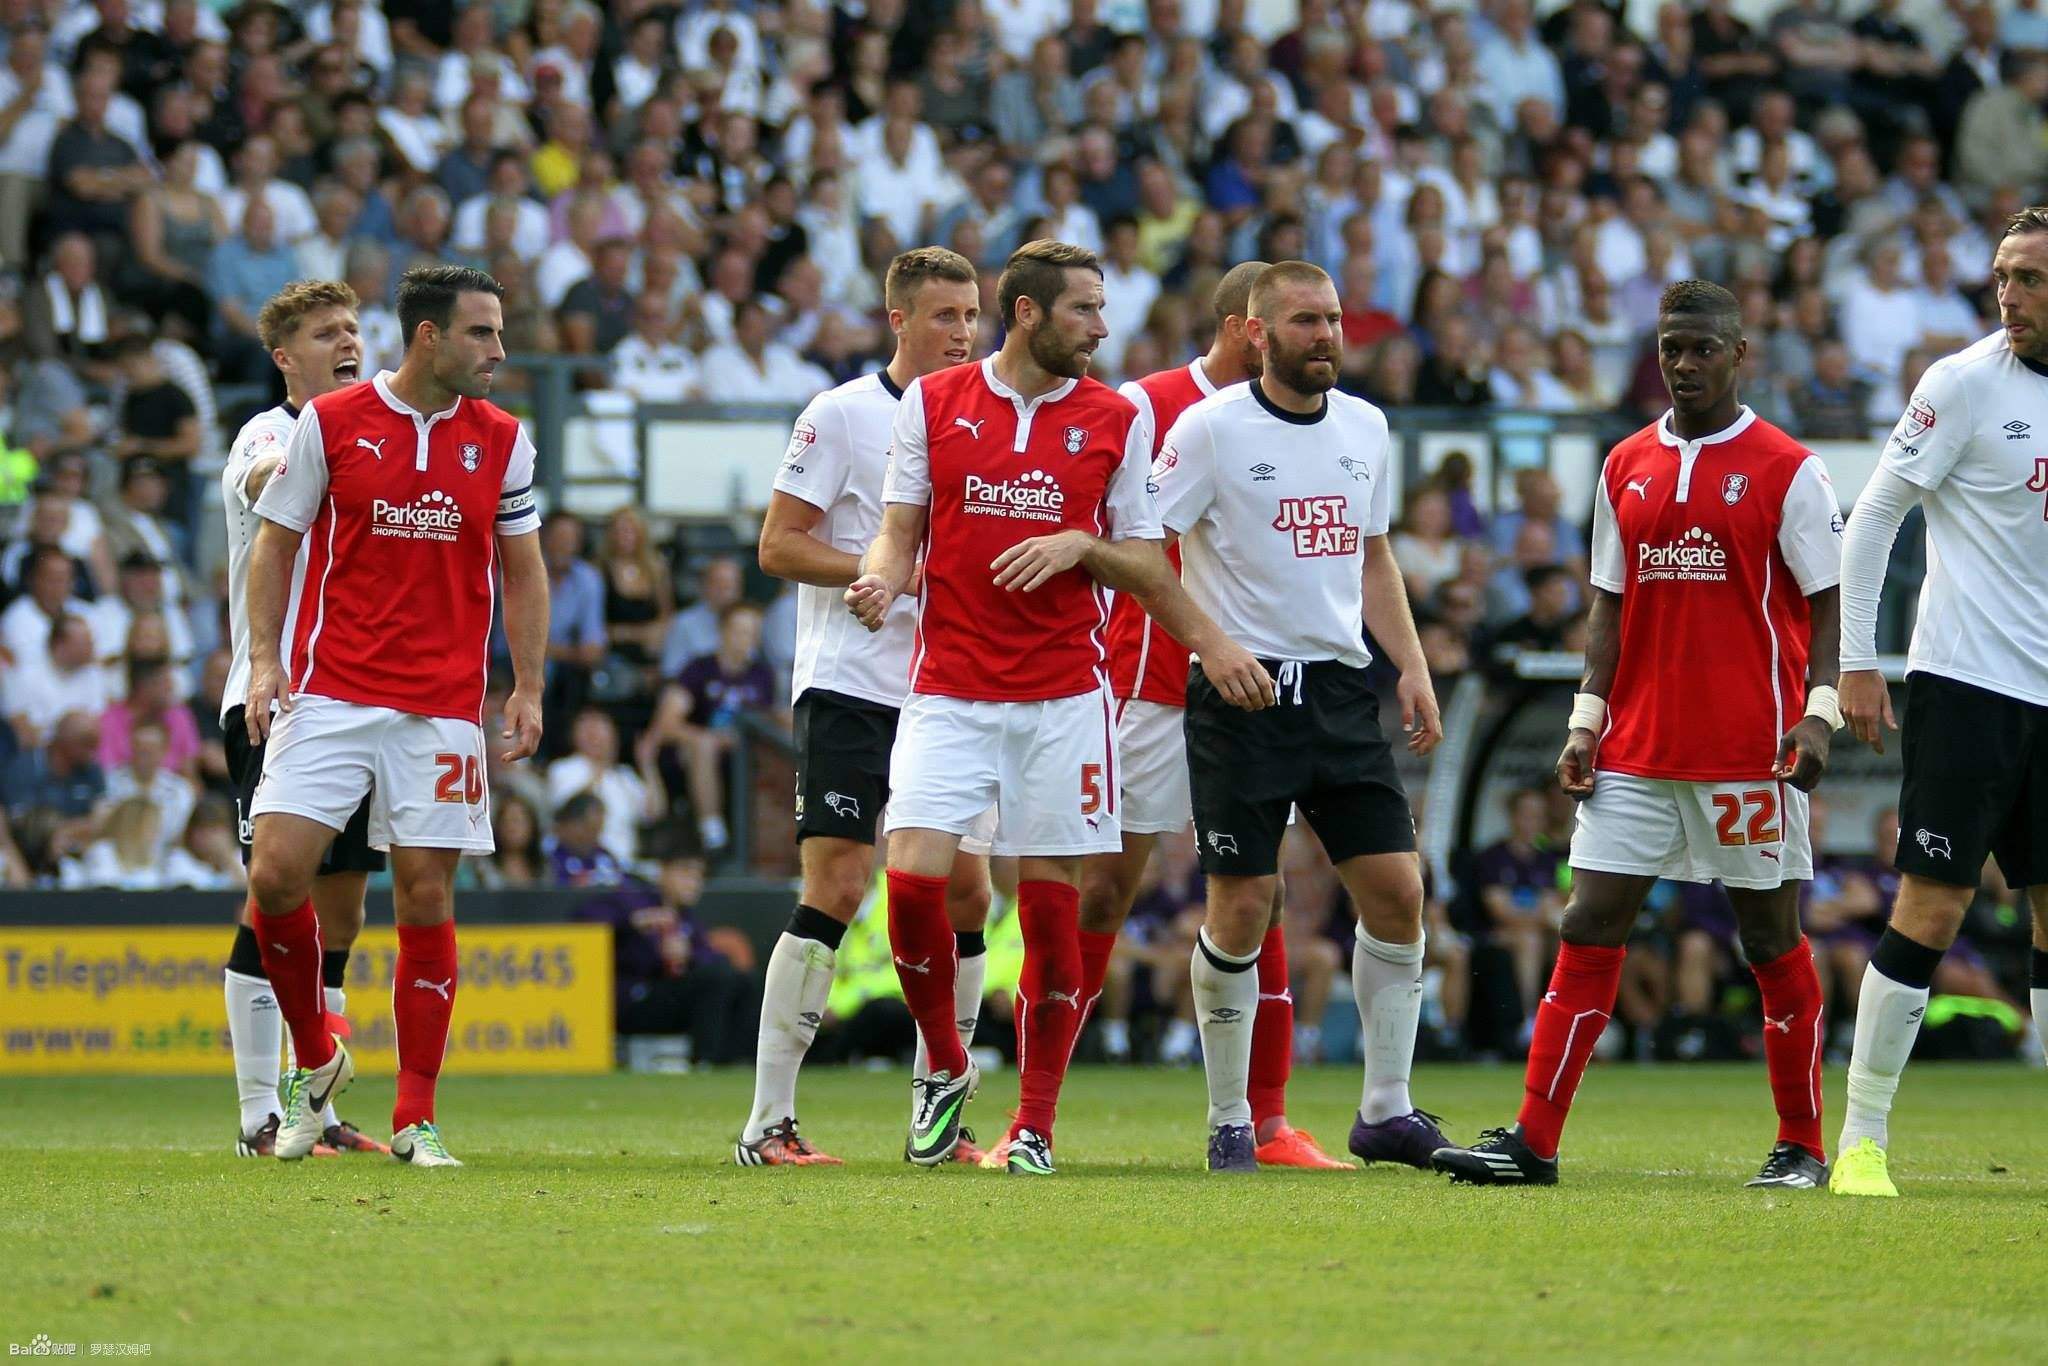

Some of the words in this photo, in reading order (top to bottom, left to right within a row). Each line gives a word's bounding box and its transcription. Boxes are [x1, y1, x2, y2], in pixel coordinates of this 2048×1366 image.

[965, 475, 1064, 511] Parkgate
[373, 499, 462, 531] Parkgate
[963, 505, 1007, 517] SHOPPING
[1009, 510, 1062, 524] ROTHERHAM
[1276, 499, 1344, 528] JUST
[371, 527, 411, 538] SHOPPING
[413, 532, 457, 542] ROTHERHAM
[1295, 527, 1345, 555] EAT
[1638, 541, 1726, 572] Parkgate
[1637, 571, 1675, 583] SHOPPING
[1677, 572, 1727, 581] ROTHERHAM
[434, 753, 482, 805] 20
[1080, 763, 1102, 815] 5
[1711, 789, 1781, 846] 22
